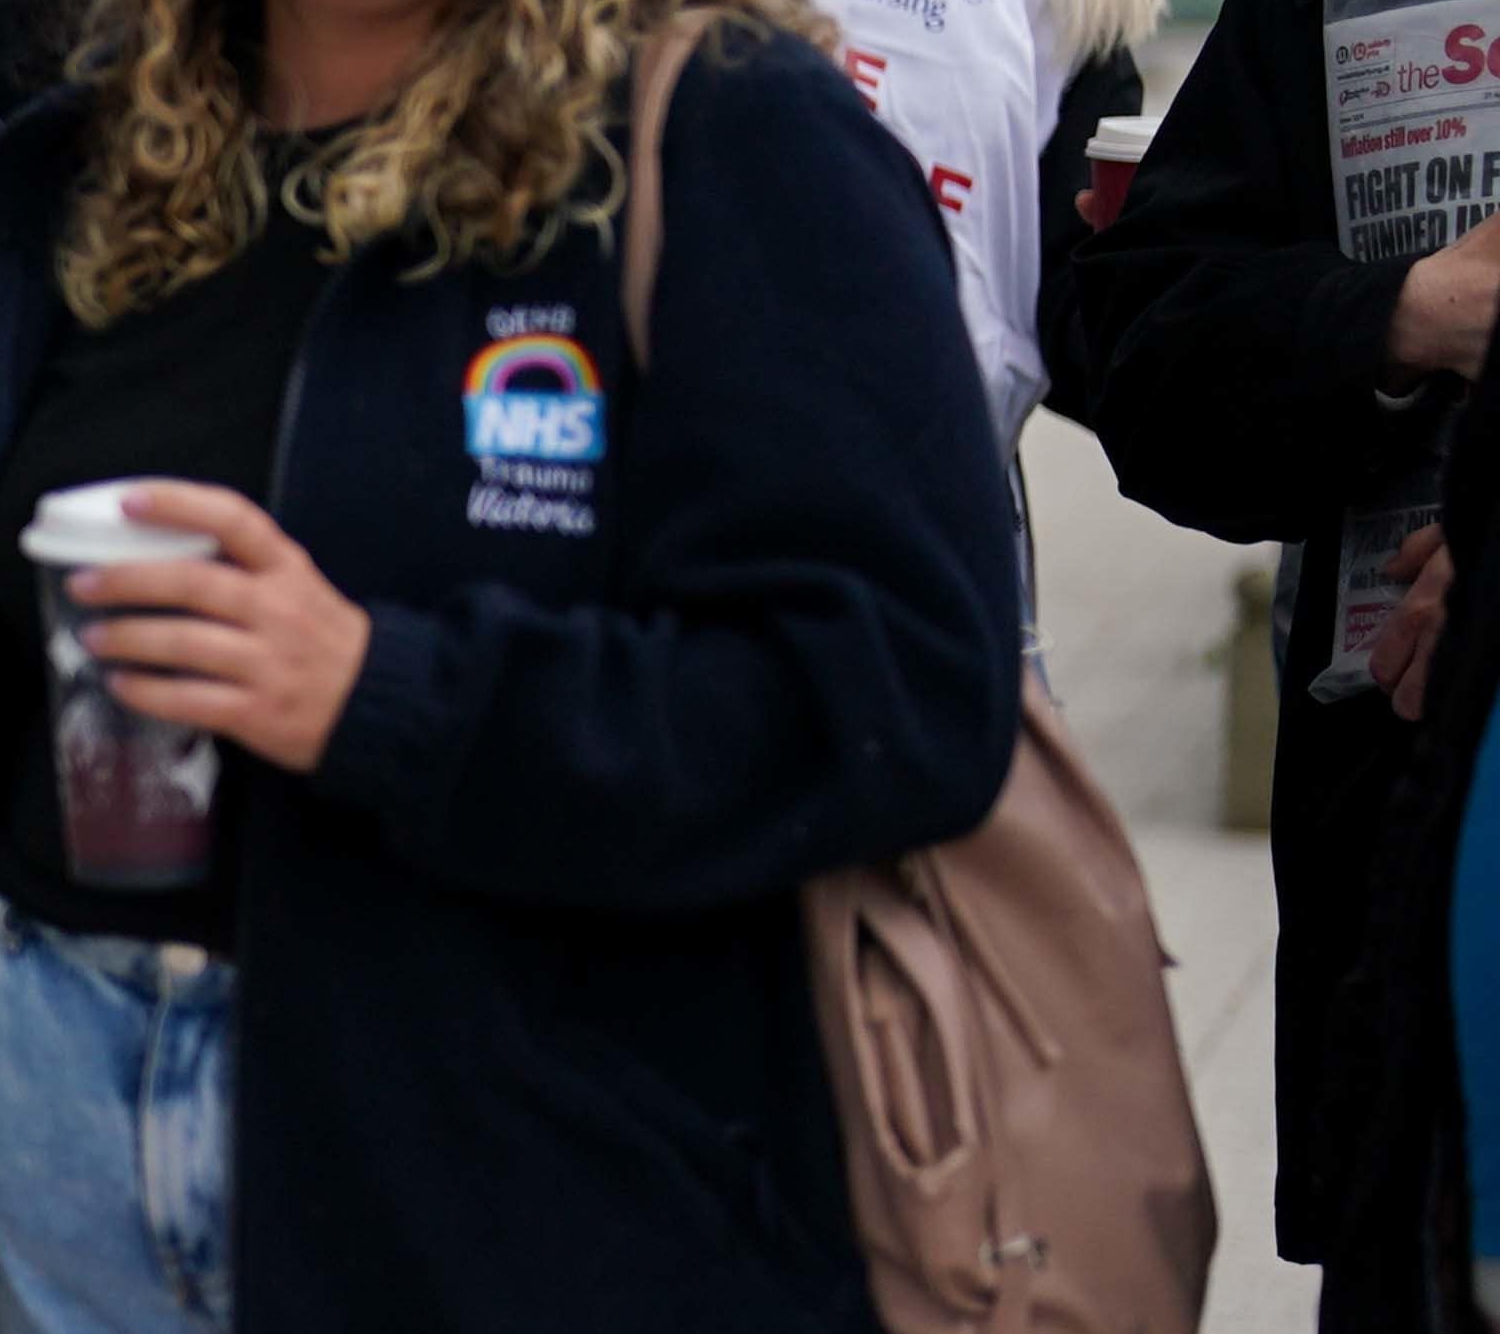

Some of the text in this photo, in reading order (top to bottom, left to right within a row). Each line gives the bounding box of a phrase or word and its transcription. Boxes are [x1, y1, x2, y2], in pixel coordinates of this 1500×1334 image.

[1397, 61, 1440, 93] the
[1341, 116, 1467, 159] Inflation still over 10%
[1345, 161, 1420, 220] FIGHT
[1426, 153, 1474, 204] ON
[477, 400, 597, 454] NHS
